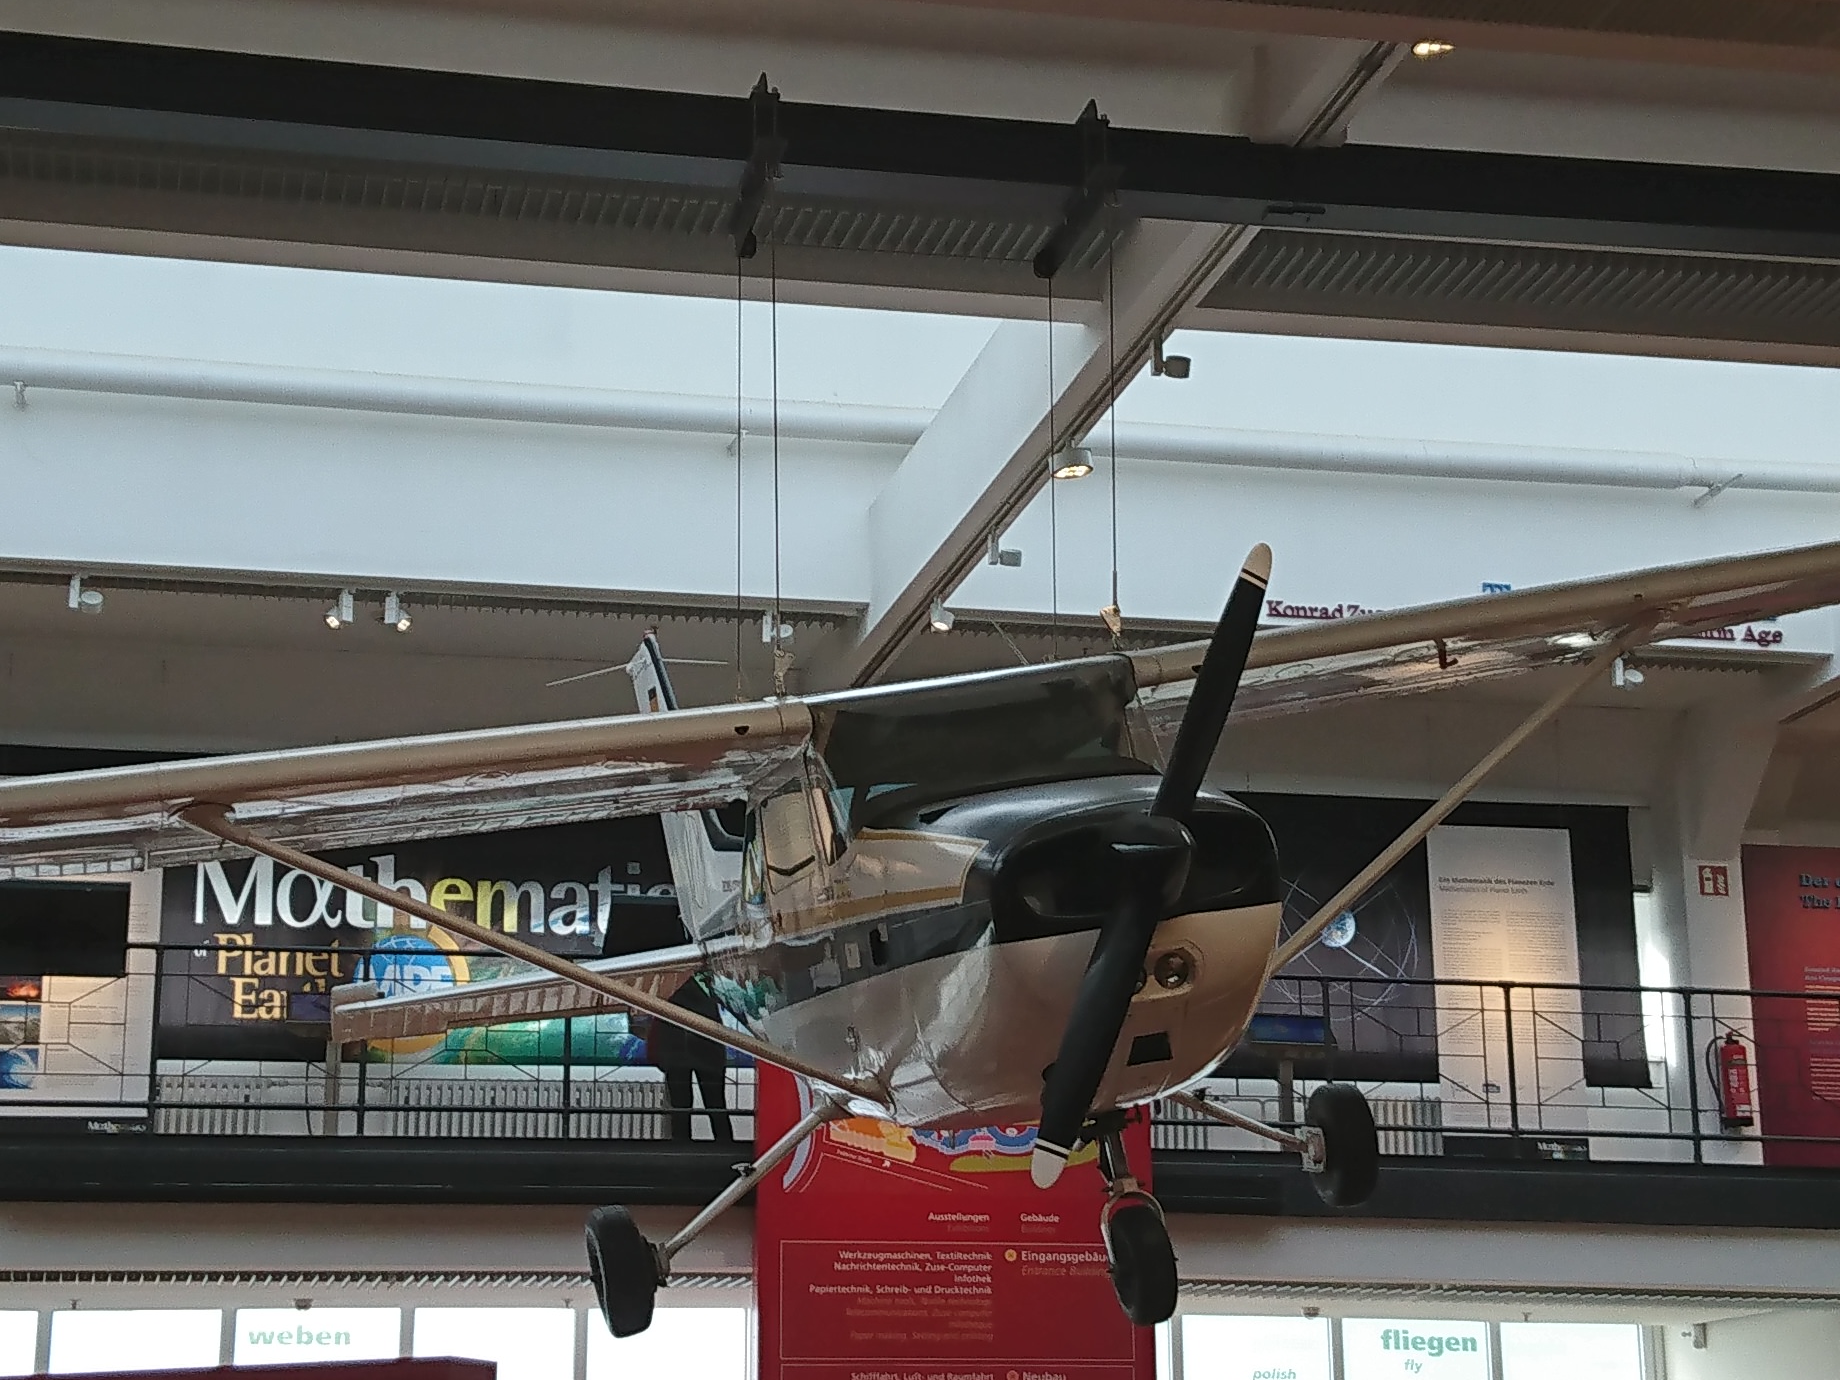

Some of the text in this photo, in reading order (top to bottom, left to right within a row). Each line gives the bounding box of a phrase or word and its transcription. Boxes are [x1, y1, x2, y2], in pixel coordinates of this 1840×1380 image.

[1266, 600, 1344, 620] Konrad
[1742, 625, 1784, 647] Age
[1799, 873, 1829, 887] Der
[1800, 894, 1831, 909] The
[213, 932, 345, 979] Planet
[1020, 1211, 1060, 1224] Gebäude
[1021, 1250, 1111, 1265] Eingangsgebäu
[248, 1326, 352, 1346] weben
[1380, 1328, 1478, 1357] fliegen
[1403, 1358, 1423, 1374] fly
